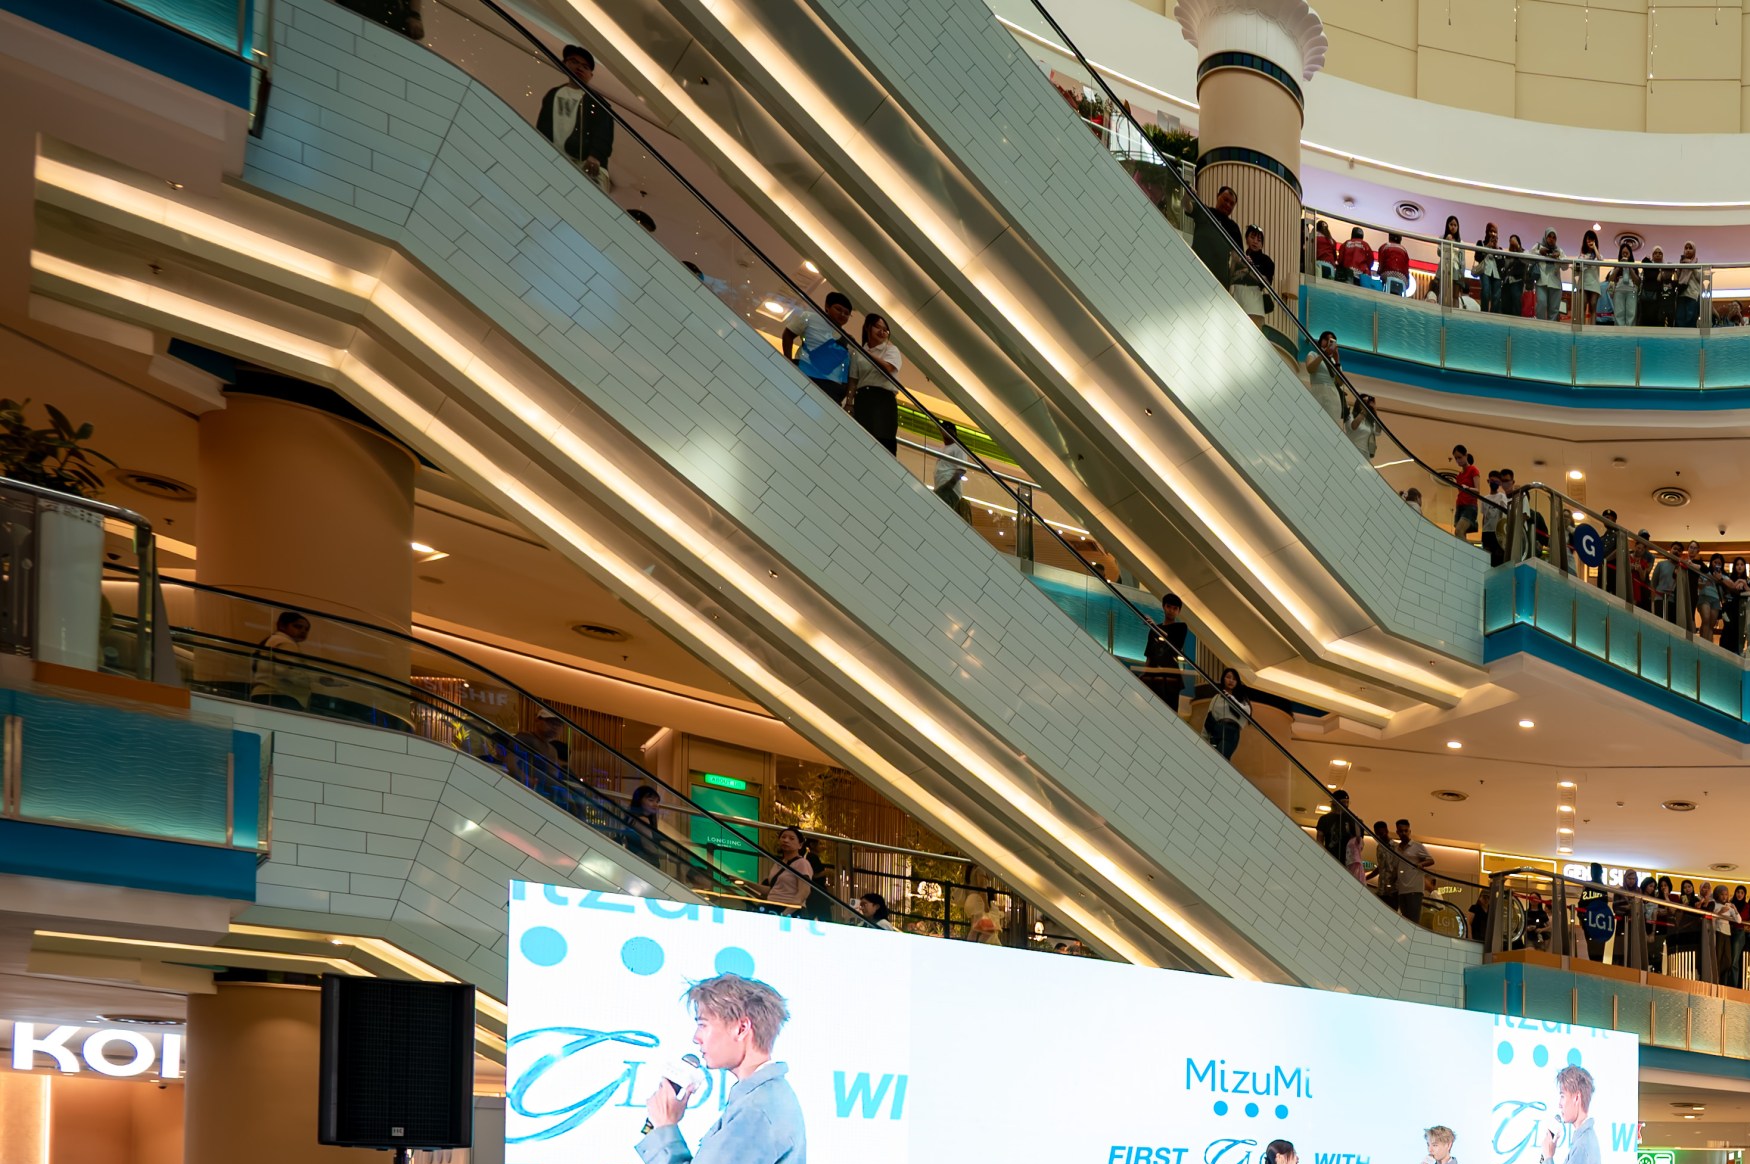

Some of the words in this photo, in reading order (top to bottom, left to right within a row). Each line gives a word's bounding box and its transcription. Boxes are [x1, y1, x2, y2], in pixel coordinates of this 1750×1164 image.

[1582, 534, 1596, 557] G
[707, 836, 742, 847] LONGJING
[1588, 911, 1613, 932] LG1
[12, 1021, 181, 1078] KOI
[1186, 1057, 1313, 1099] MizuMi
